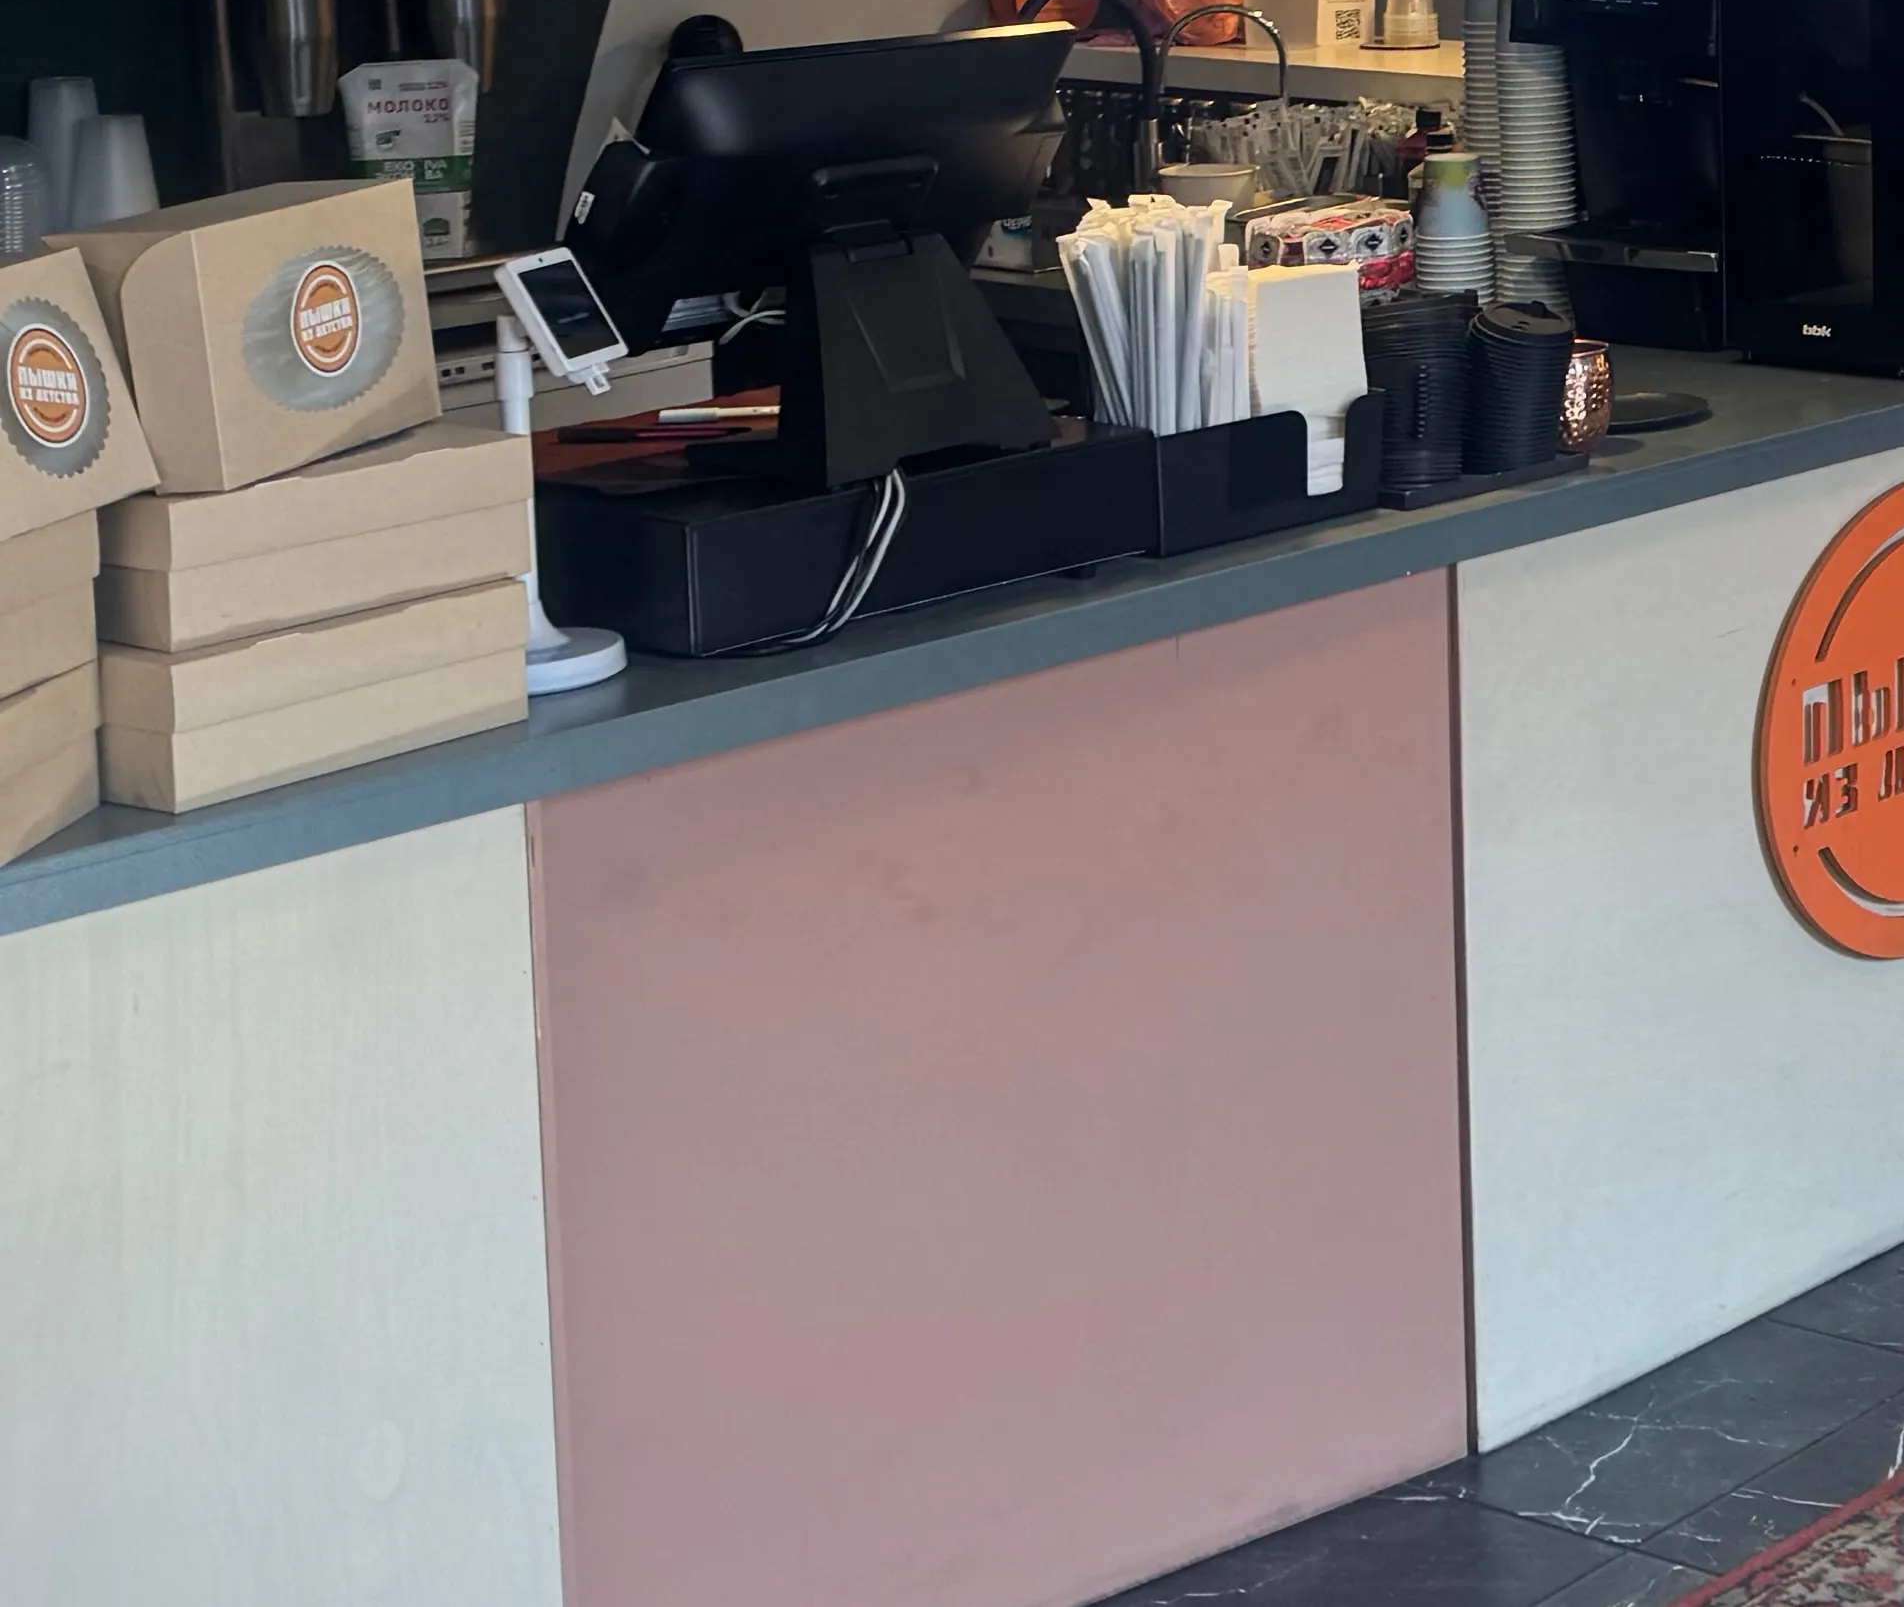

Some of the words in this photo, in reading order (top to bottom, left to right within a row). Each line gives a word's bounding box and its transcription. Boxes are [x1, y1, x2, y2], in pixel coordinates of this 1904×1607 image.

[367, 98, 449, 114] МОЛОКО
[1803, 324, 1831, 337] bbk
[1803, 762, 1858, 830] ИЗ
